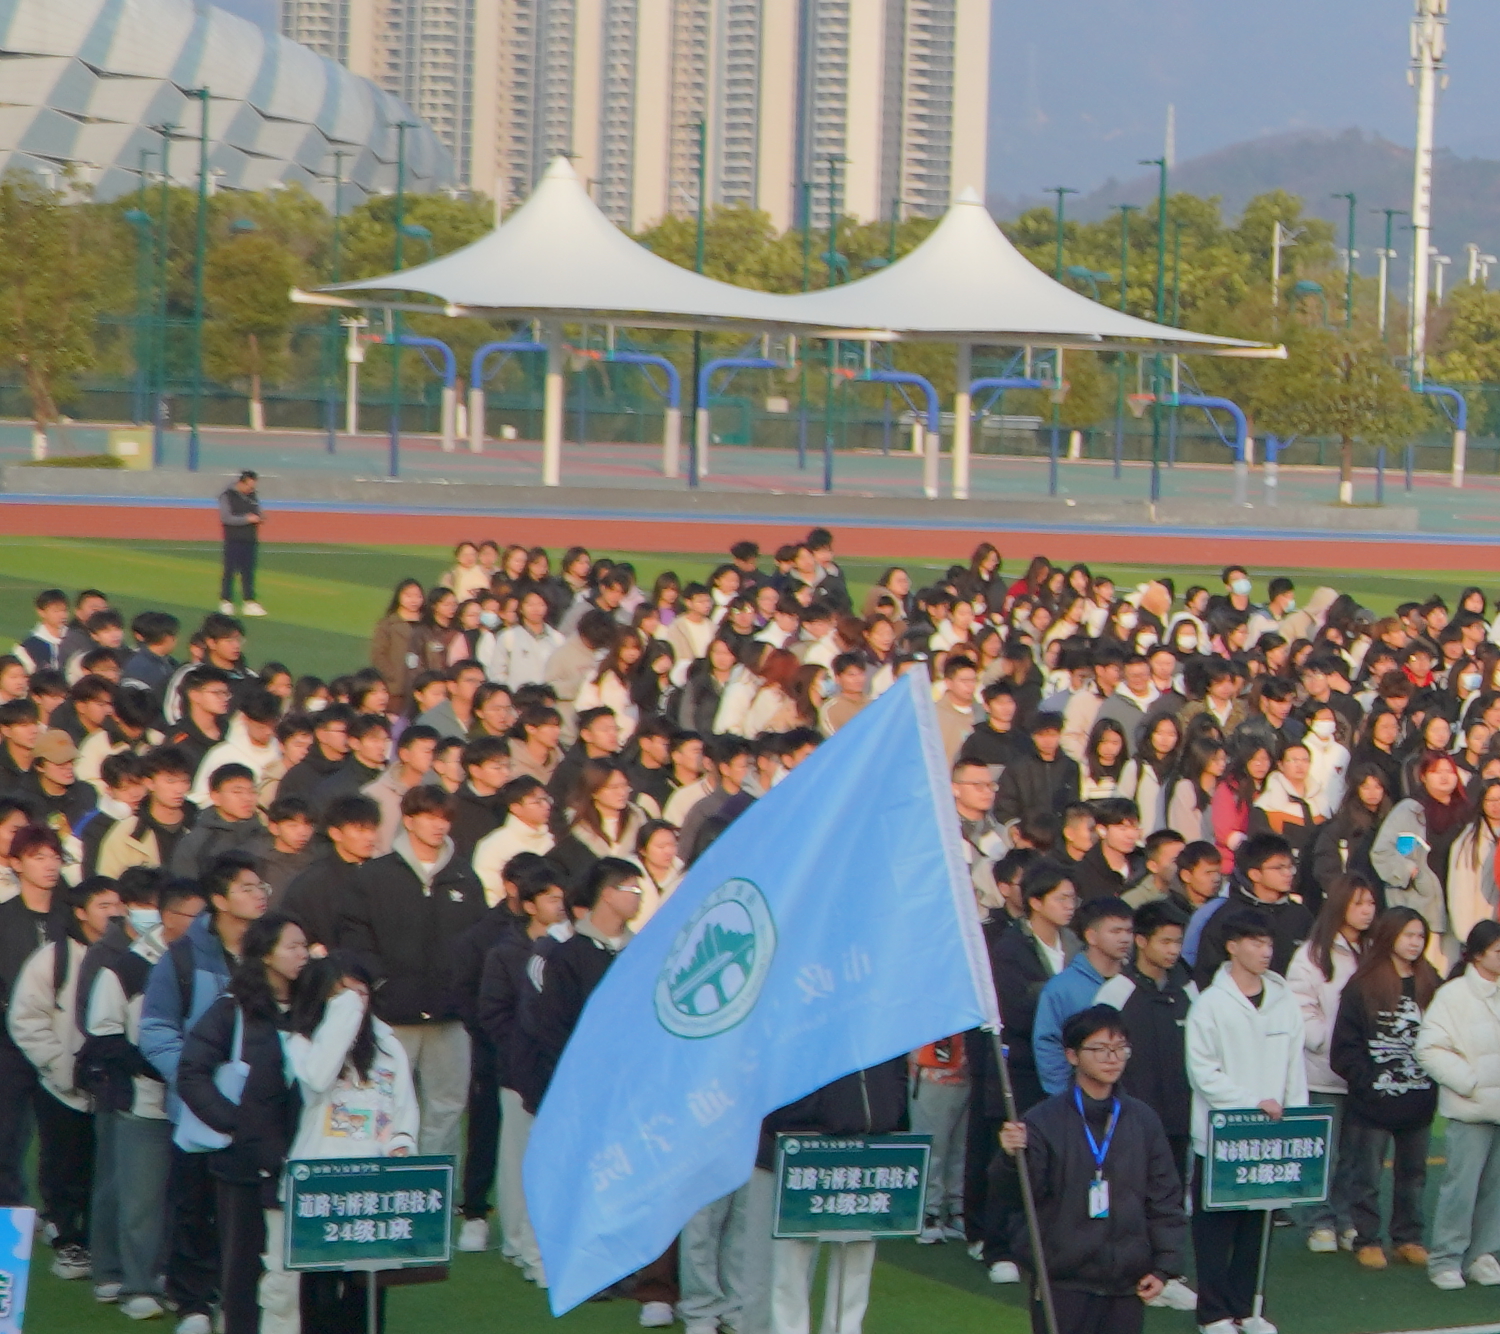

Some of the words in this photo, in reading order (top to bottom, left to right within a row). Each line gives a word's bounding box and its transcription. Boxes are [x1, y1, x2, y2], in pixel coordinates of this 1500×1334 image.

[1215, 1137, 1324, 1162] 城市轨道交通工程技术
[786, 1166, 919, 1190] 道路与桥梁工程技术
[1236, 1162, 1301, 1184] 24级2班
[297, 1189, 443, 1217] 道路与桥梁工程技术
[810, 1192, 892, 1215] 24级2班
[323, 1217, 412, 1243] 24级1班
